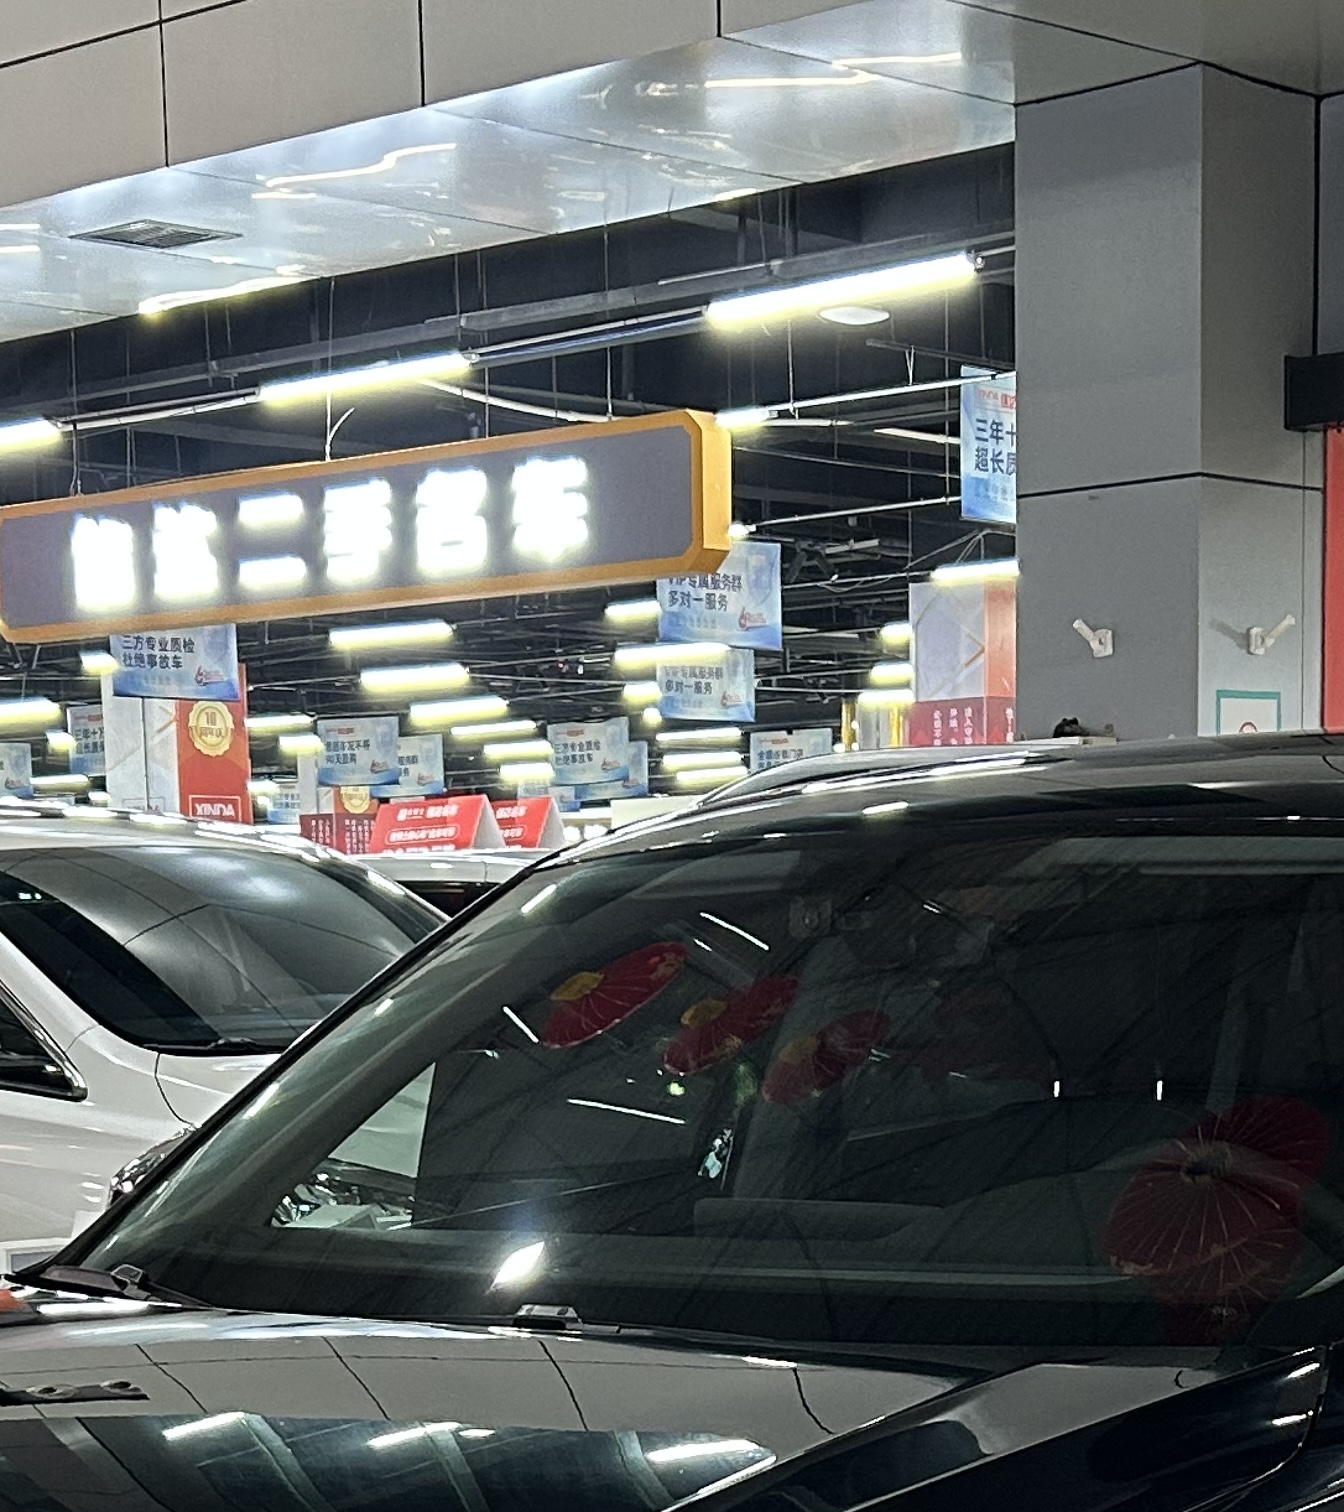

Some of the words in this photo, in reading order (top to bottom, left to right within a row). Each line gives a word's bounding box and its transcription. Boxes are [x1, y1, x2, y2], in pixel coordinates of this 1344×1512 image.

[667, 591, 729, 612] 多对一服务
[121, 635, 196, 654] 三方专业质检
[121, 652, 184, 670] 杜绝事故车
[195, 803, 235, 817] XINDA
